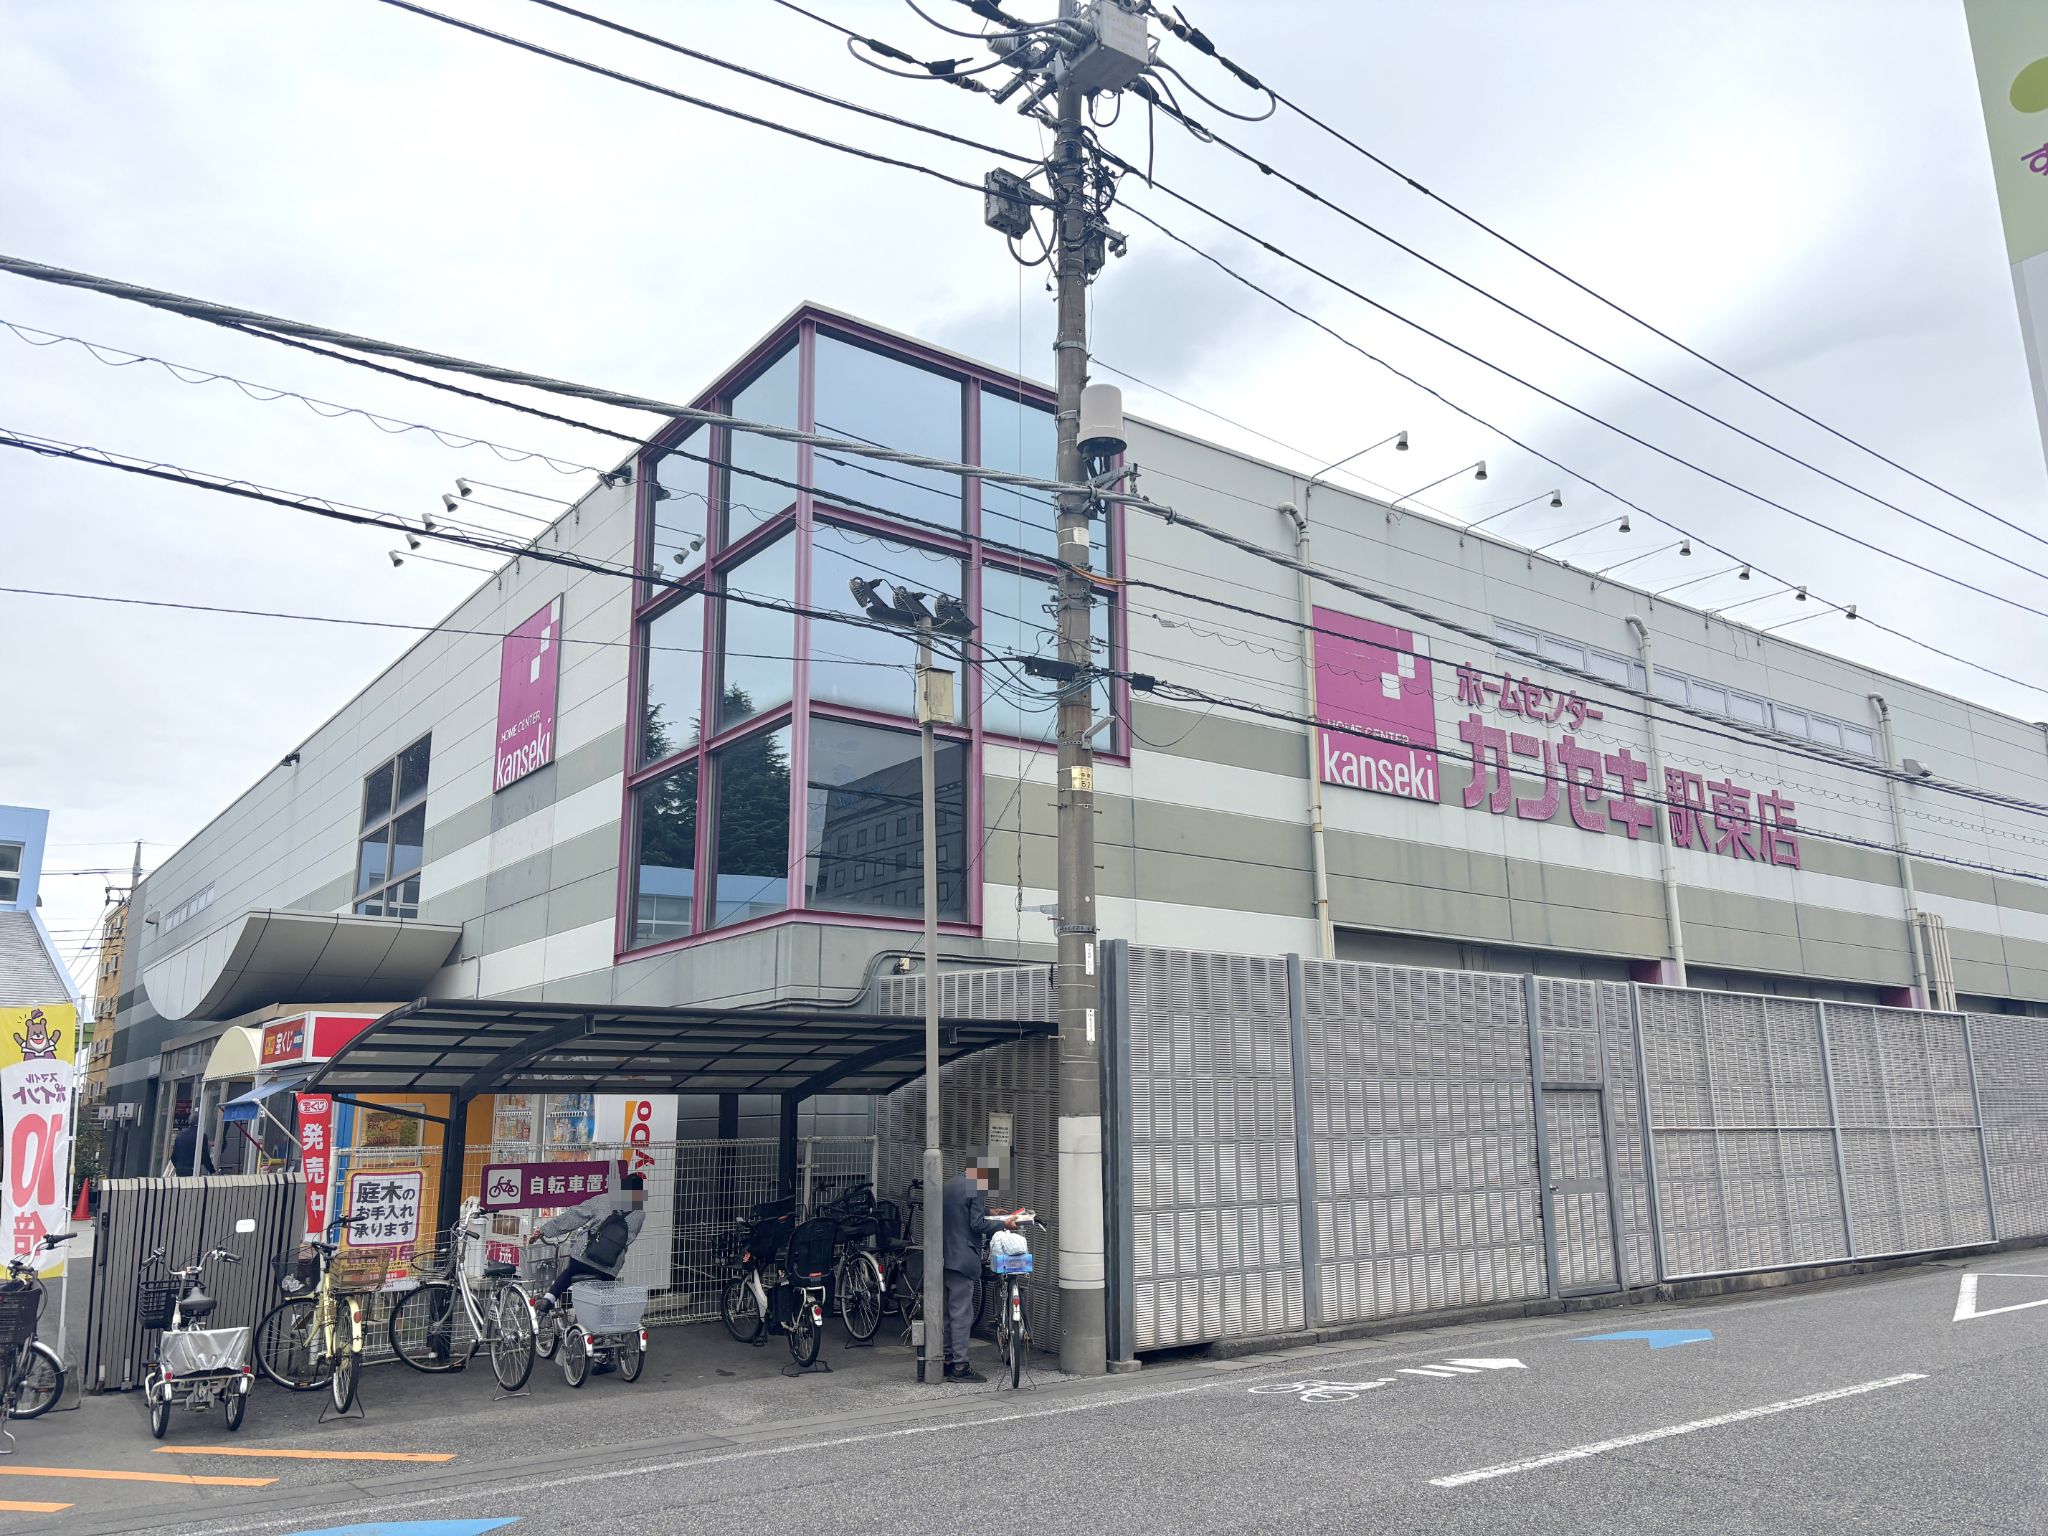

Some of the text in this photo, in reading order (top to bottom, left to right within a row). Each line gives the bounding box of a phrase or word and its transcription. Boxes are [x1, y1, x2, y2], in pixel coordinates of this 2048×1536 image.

[1457, 661, 1604, 730] ホームセンター
[501, 710, 541, 742] HOME CENTER
[496, 717, 551, 790] kanseki
[1323, 733, 1435, 801] kanseki
[1458, 712, 1801, 871] カンセキ 駅東店
[302, 1100, 325, 1112] 宝くじ
[631, 1100, 655, 1179] yDo
[356, 1181, 416, 1204] 庭木の
[530, 1174, 608, 1195] 自転車置
[355, 1204, 415, 1220] お手入れ
[354, 1220, 413, 1239] 承ります
